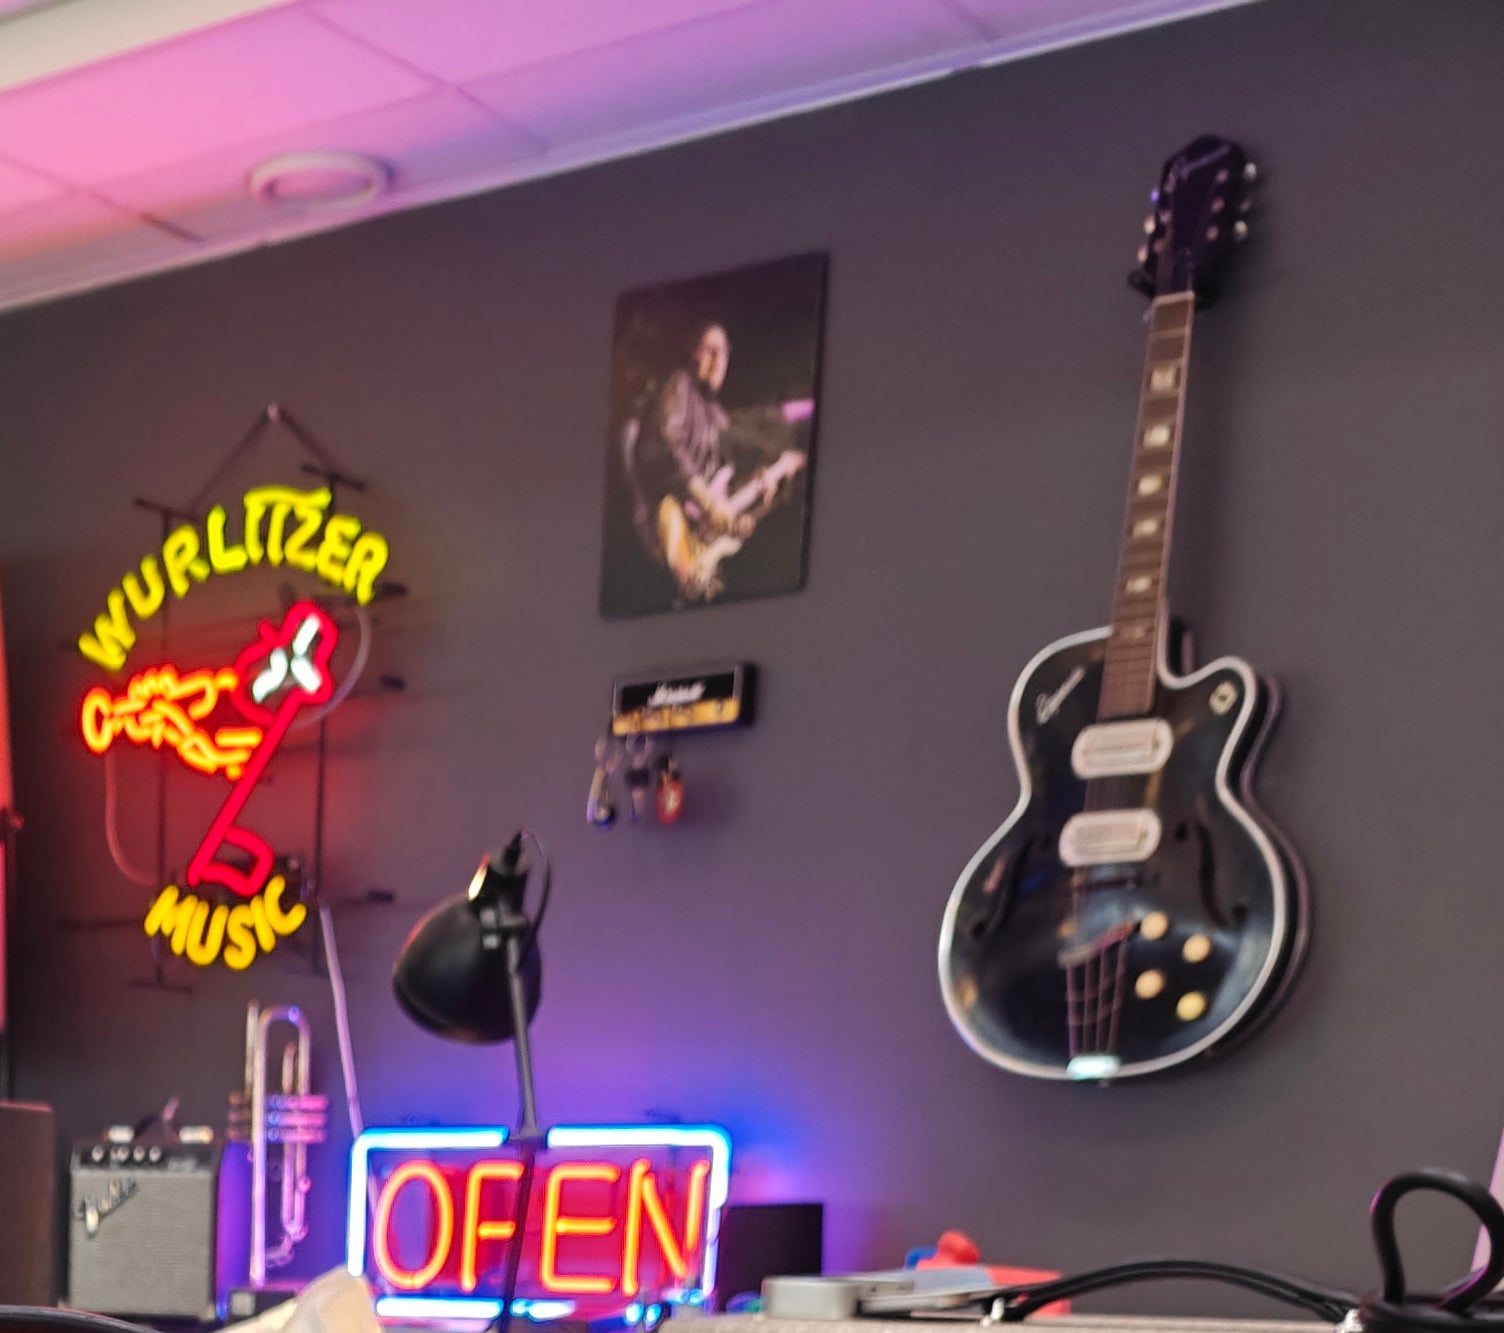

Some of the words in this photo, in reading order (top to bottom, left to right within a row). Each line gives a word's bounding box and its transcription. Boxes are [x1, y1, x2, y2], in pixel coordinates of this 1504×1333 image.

[78, 485, 390, 672] WURLITZER
[144, 875, 308, 970] MUSIC
[373, 1158, 711, 1297] OPEN
